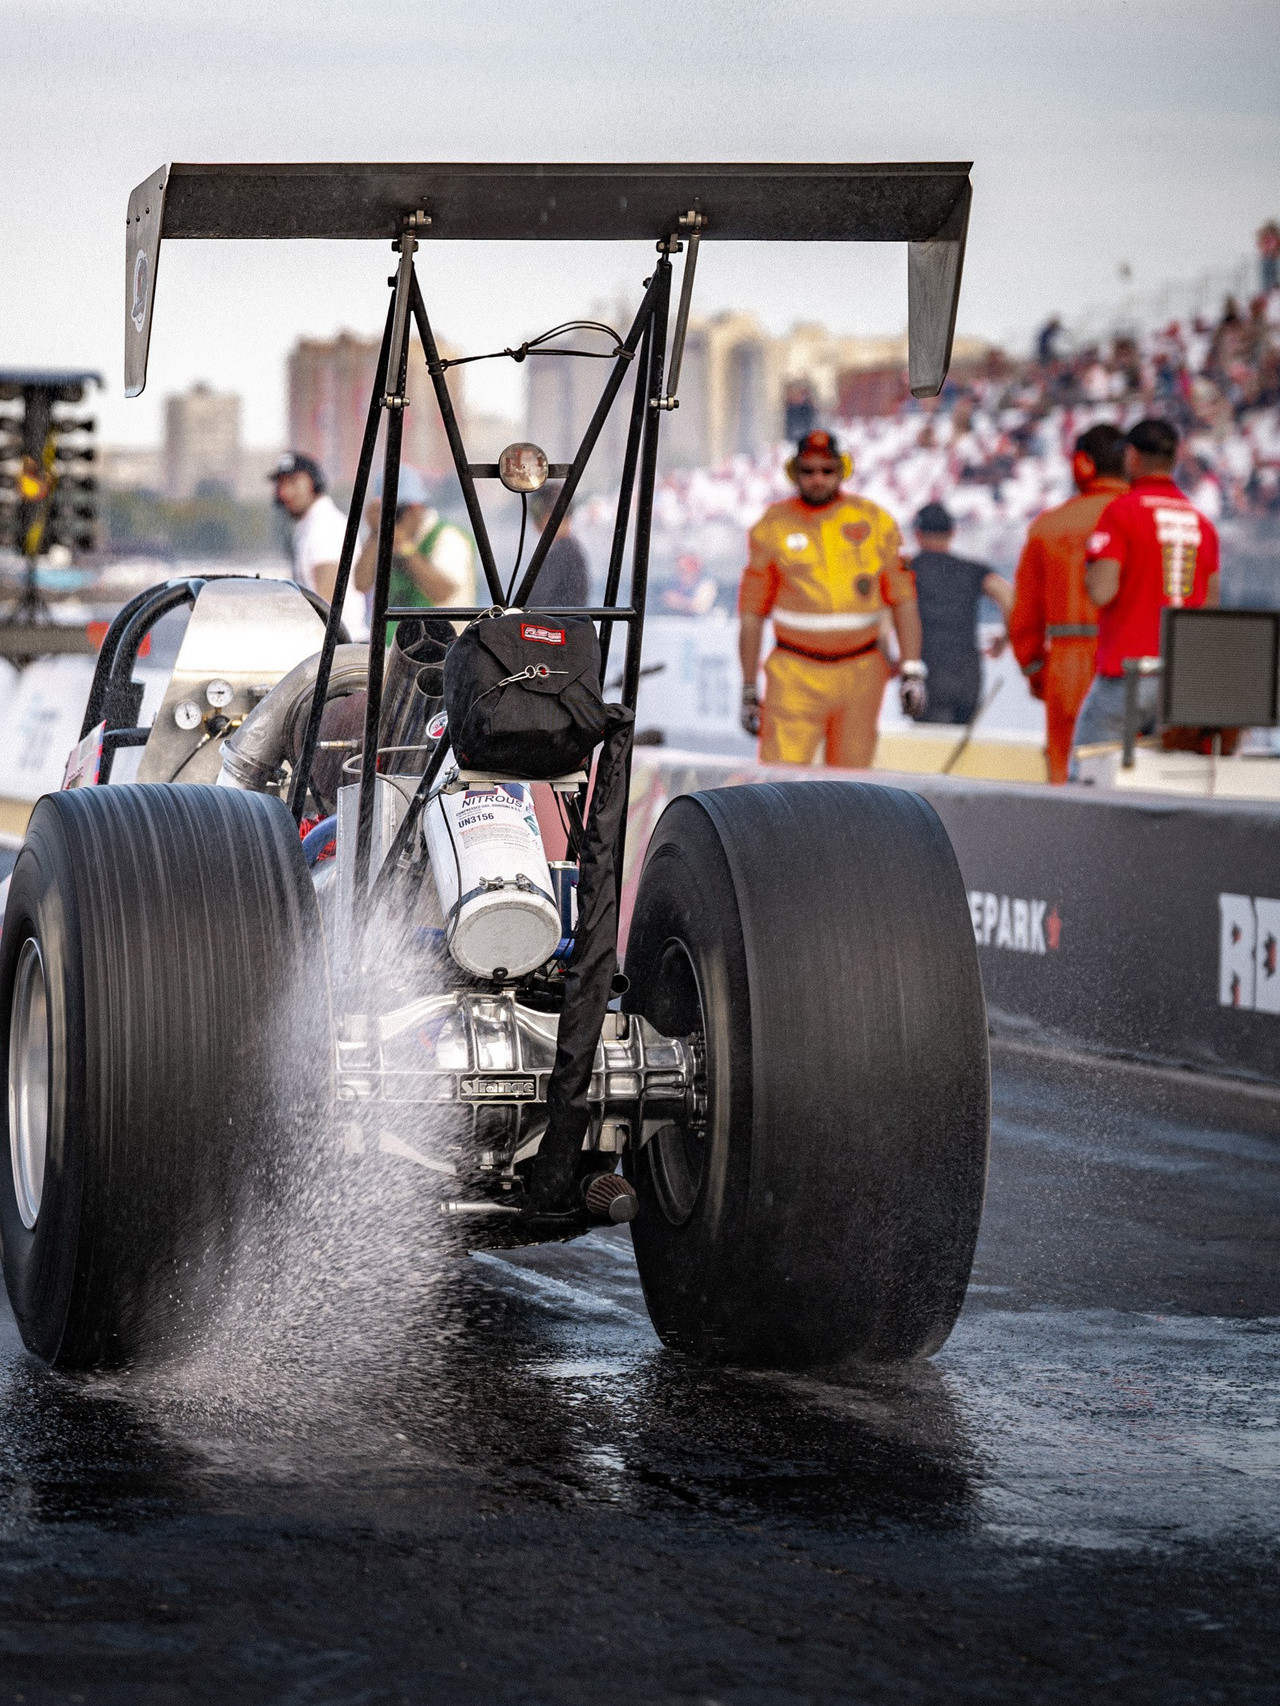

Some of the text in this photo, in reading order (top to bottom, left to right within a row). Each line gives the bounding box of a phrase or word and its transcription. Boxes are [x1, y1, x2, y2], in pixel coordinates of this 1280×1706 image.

[462, 795, 523, 808] NITROUS
[458, 812, 494, 828] UN3156
[461, 1078, 535, 1098] Strange
